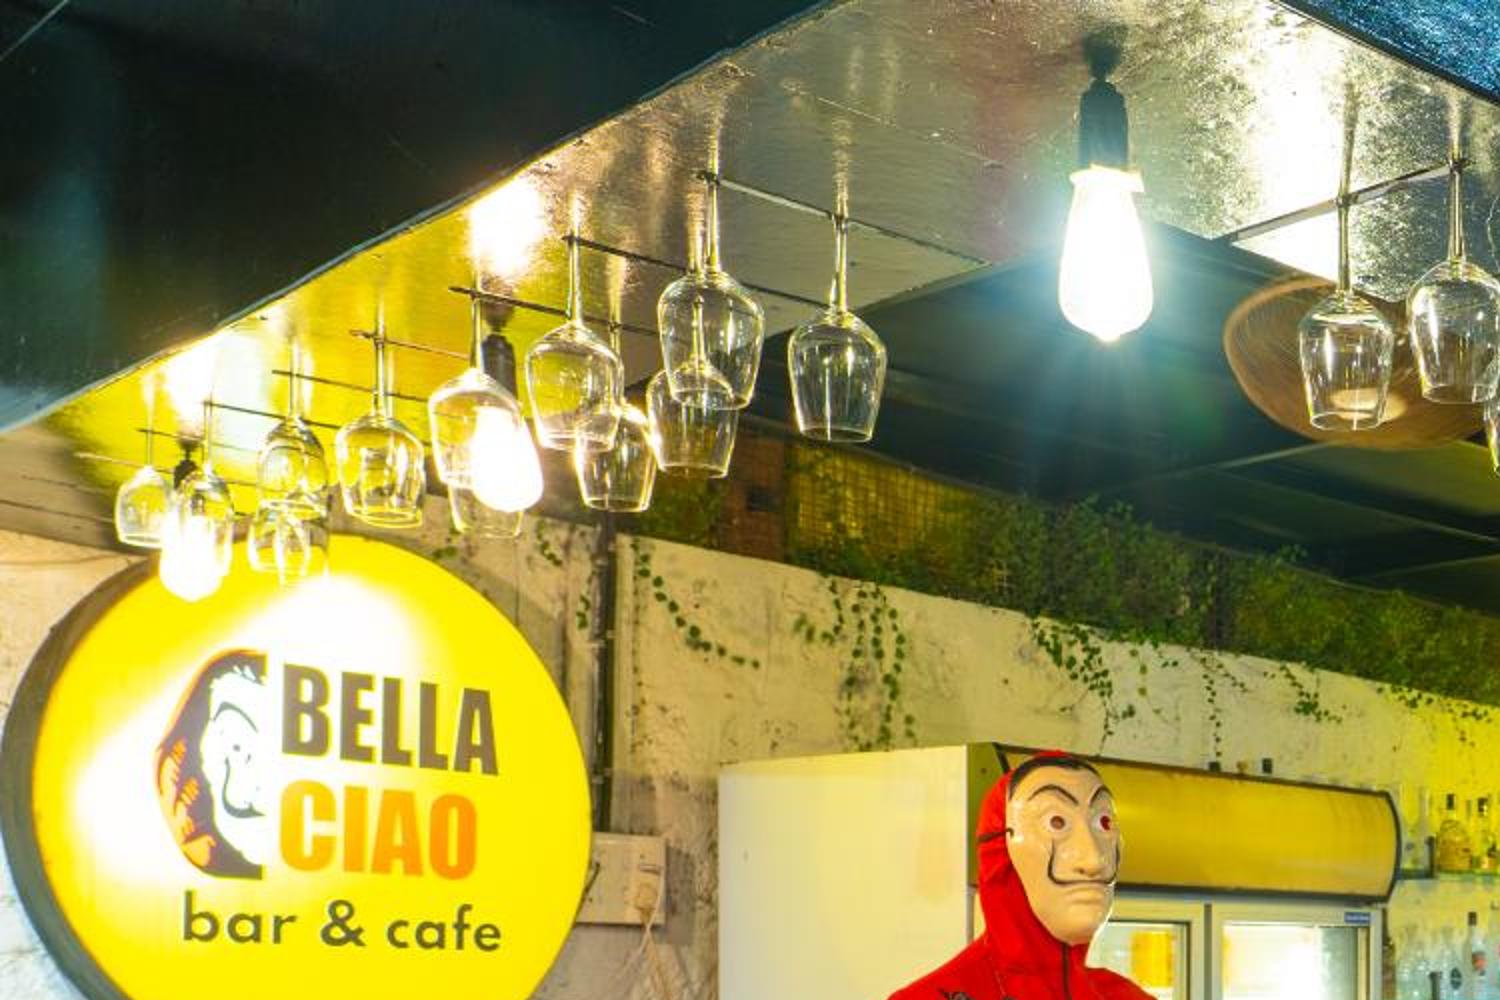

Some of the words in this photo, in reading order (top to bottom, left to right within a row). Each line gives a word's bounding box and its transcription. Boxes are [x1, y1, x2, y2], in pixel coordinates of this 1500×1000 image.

[282, 663, 499, 776] BELLA
[279, 779, 478, 881] CIAO
[183, 889, 297, 944] bar
[320, 899, 367, 947] &
[386, 903, 502, 952] cafe
